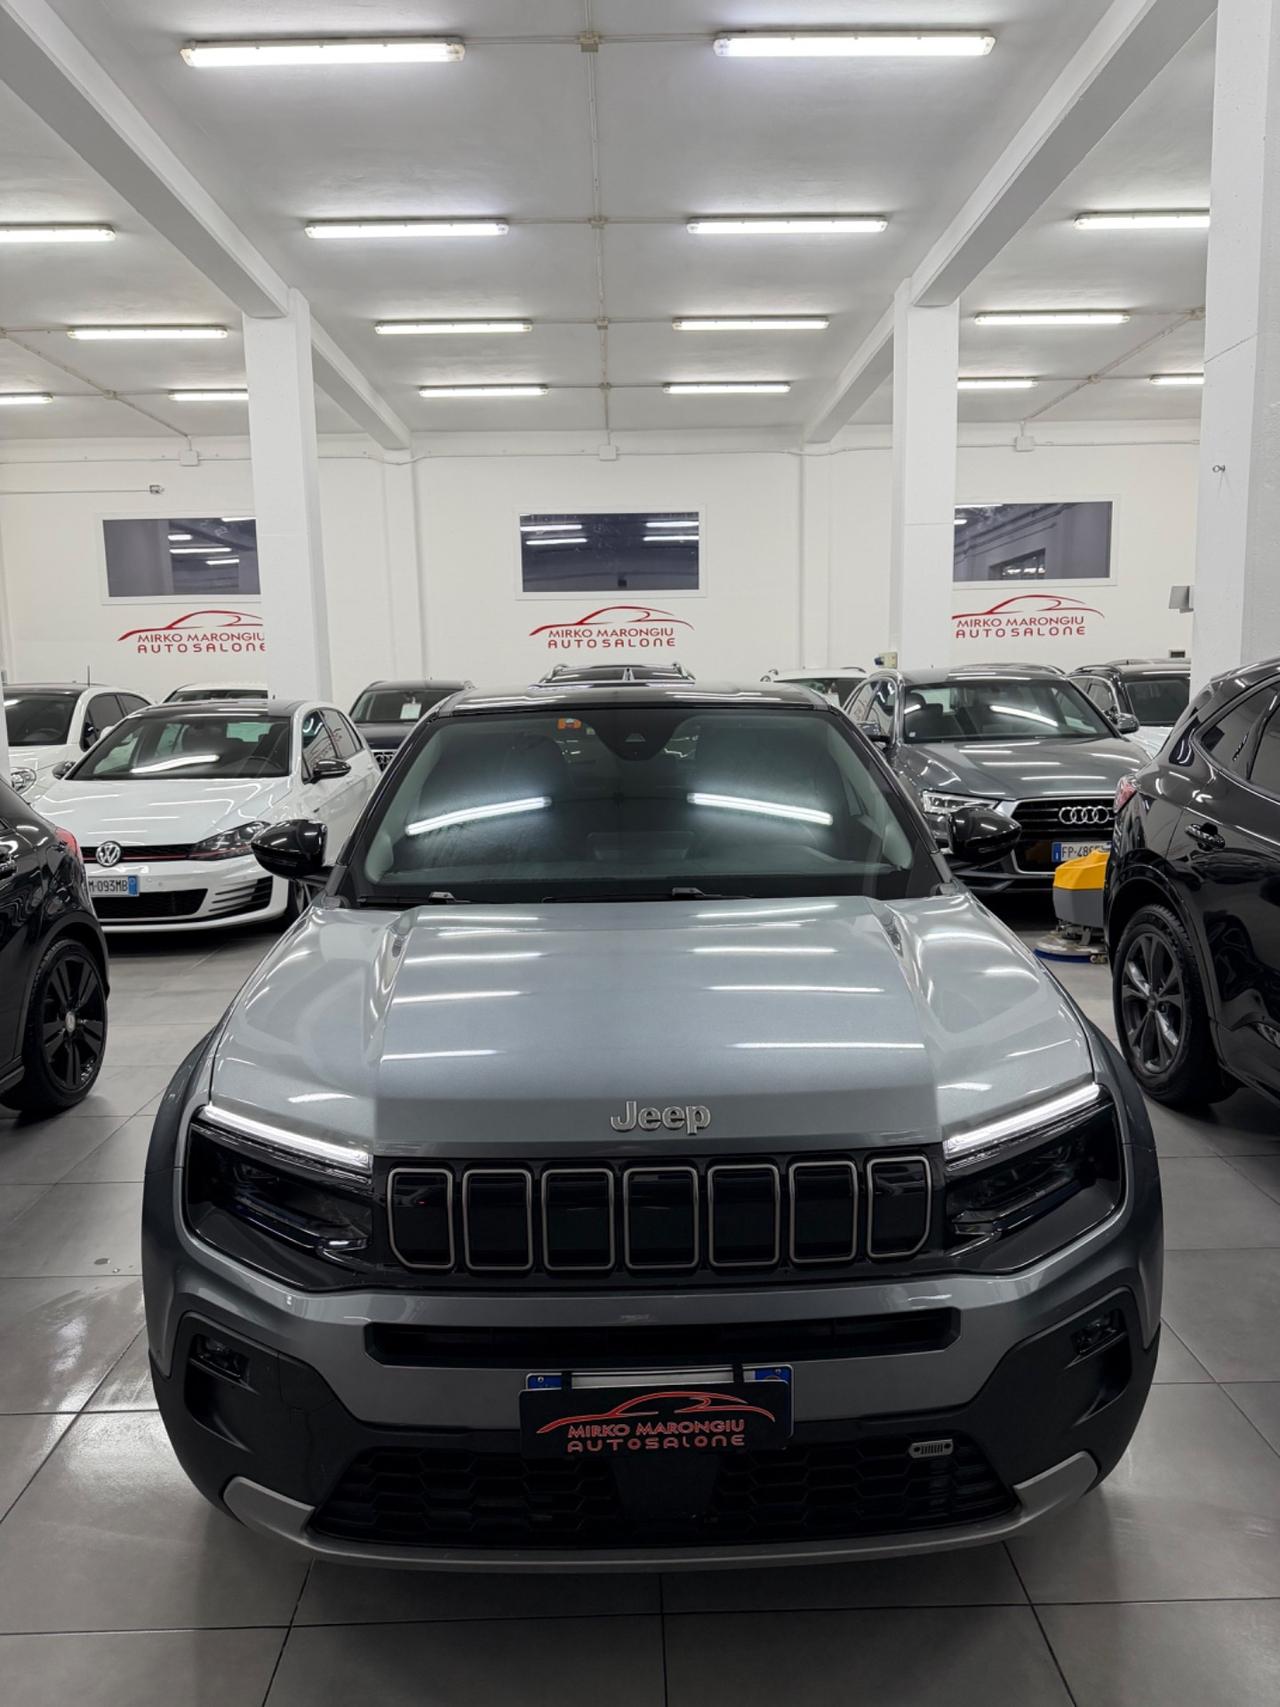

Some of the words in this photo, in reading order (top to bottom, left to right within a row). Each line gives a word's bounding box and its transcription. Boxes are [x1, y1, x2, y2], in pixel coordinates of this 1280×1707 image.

[957, 617, 1002, 628] MIRKO
[1005, 616, 1084, 627] MARONGIU
[138, 633, 182, 642] MIRKO
[548, 628, 593, 638] MIRKO
[596, 627, 674, 638] MARONGIU
[955, 626, 1086, 639] AUTOSALONE
[547, 637, 676, 649] AUTOSALONE
[610, 1100, 711, 1135] Jeep
[568, 1423, 629, 1438] MIRKO
[636, 1419, 744, 1435] MARONGIU
[568, 1435, 744, 1453] AUTOSALONE
